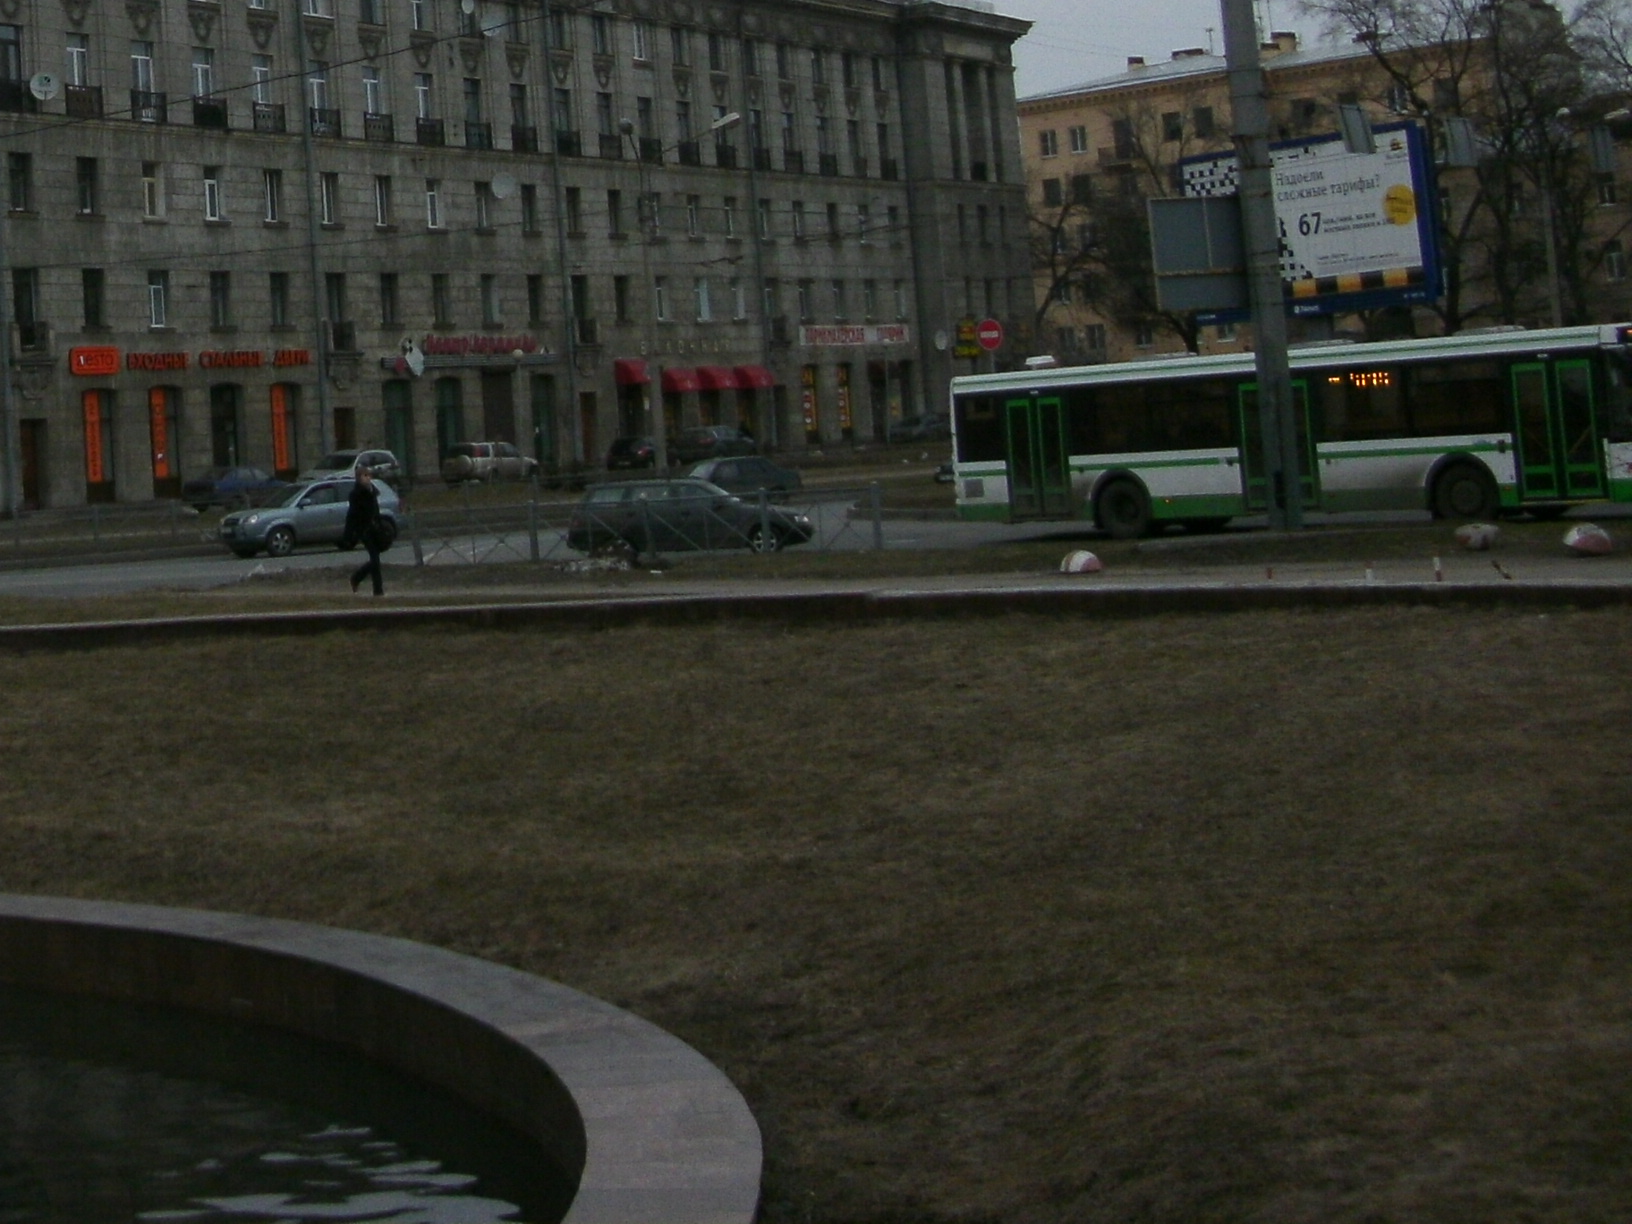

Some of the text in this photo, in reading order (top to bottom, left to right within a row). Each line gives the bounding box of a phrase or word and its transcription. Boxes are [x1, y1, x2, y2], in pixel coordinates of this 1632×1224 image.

[1274, 171, 1324, 187] Надоели
[1277, 174, 1381, 202] сложные тарифы?
[1298, 212, 1321, 236] 67
[126, 349, 311, 371] ВХОДНЫЕ СТАЛЬНЫЕ ДВЕРИ
